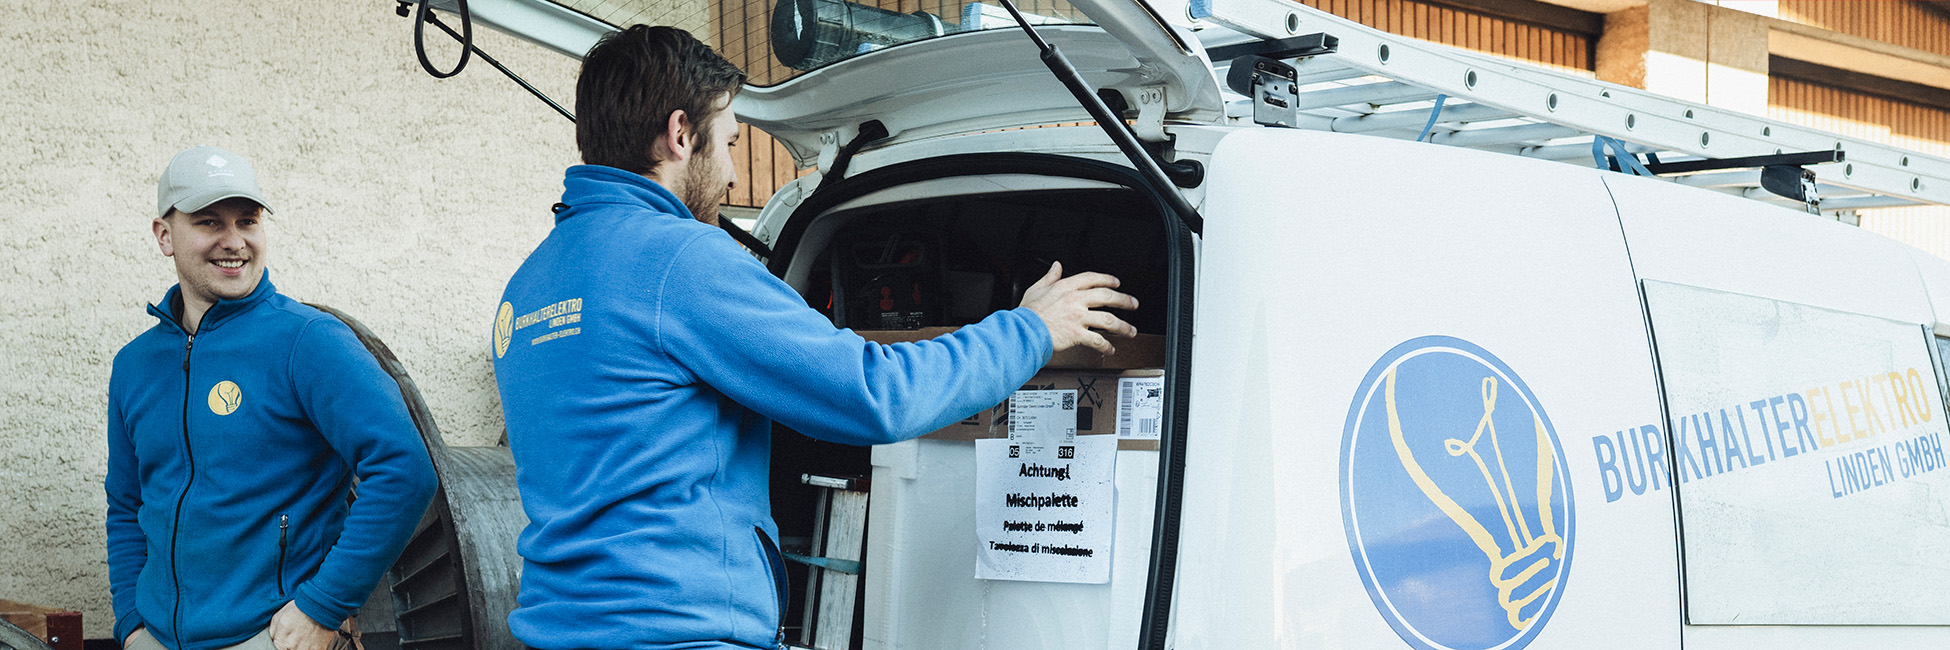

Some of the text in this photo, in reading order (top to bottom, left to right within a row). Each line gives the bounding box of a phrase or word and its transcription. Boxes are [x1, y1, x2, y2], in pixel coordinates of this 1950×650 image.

[515, 298, 582, 330] BURKHALTERELEKTRO
[1592, 367, 1932, 503] BURKHALTERELEKTRO
[1009, 447, 1020, 457] 05
[1059, 447, 1074, 457] 316
[1825, 432, 1947, 499] LINDEN GMBH
[1006, 492, 1079, 511] Mischpalette
[1034, 520, 1046, 532] de
[1031, 543, 1039, 553] di
